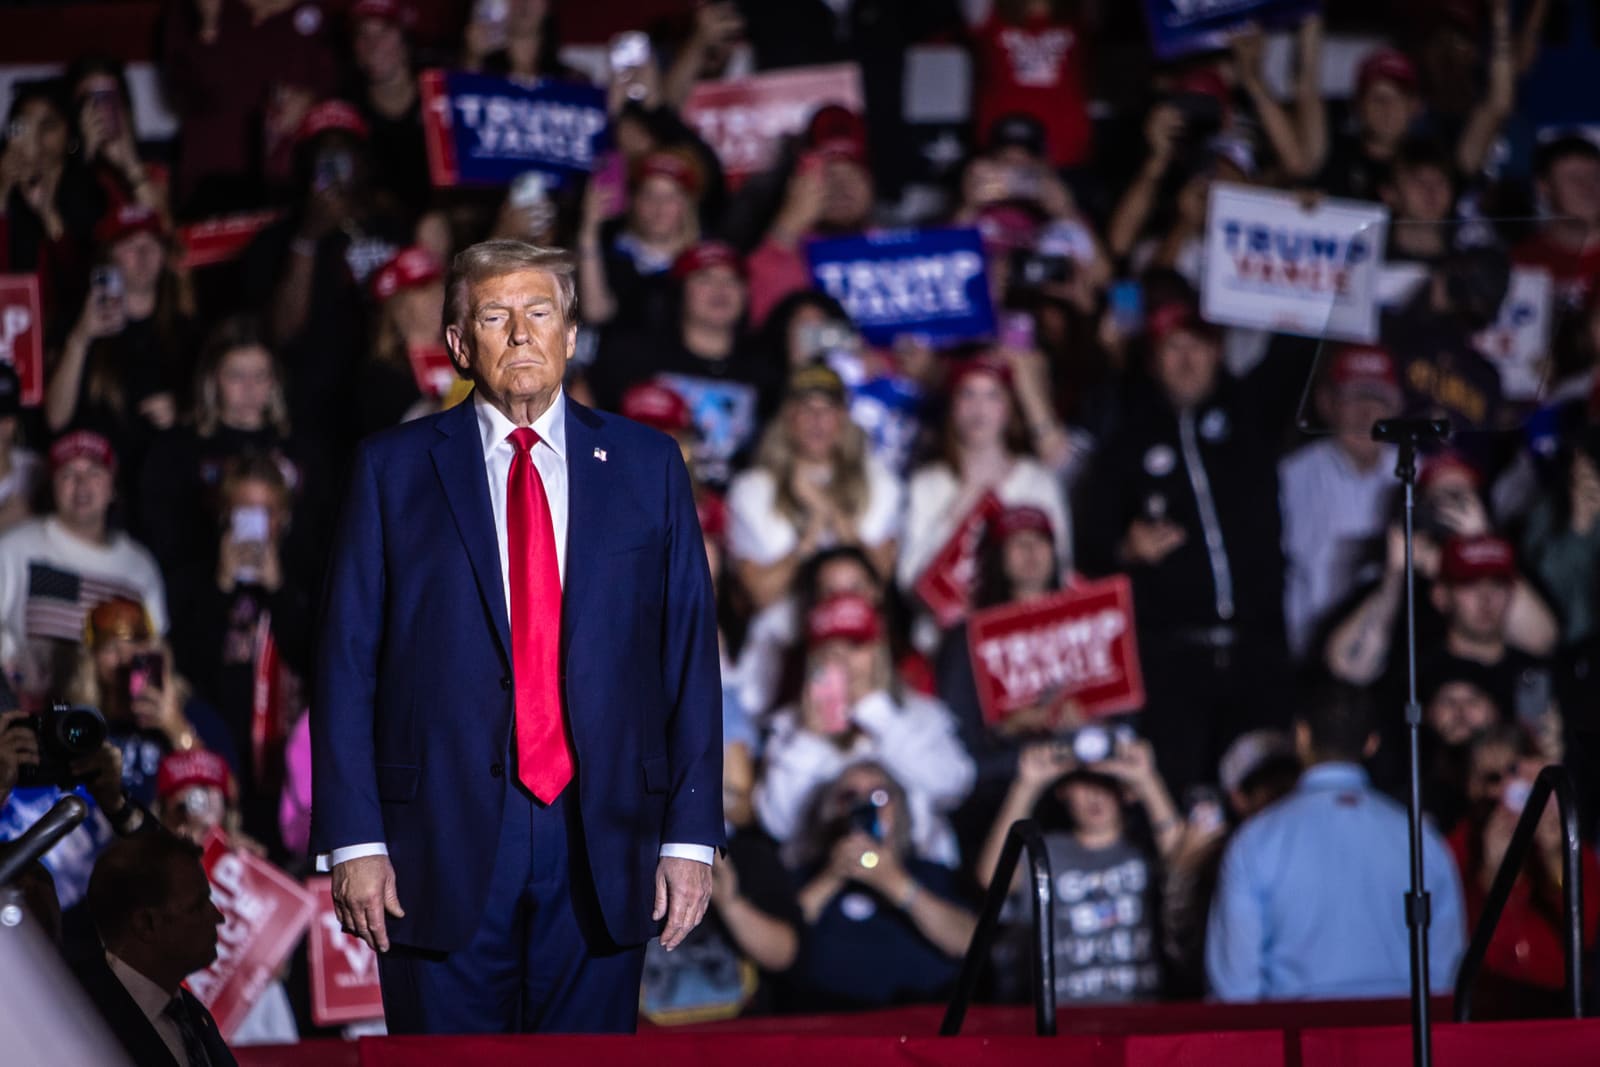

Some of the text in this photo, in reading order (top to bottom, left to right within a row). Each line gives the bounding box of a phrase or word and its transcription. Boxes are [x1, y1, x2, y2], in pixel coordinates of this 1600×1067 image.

[455, 93, 607, 137] TRUMP
[473, 121, 596, 164] VANCE
[1220, 219, 1371, 270] TRUMP
[815, 249, 983, 300] TRUMP
[1231, 255, 1349, 295] VANCE
[976, 606, 1127, 677] TRUMP
